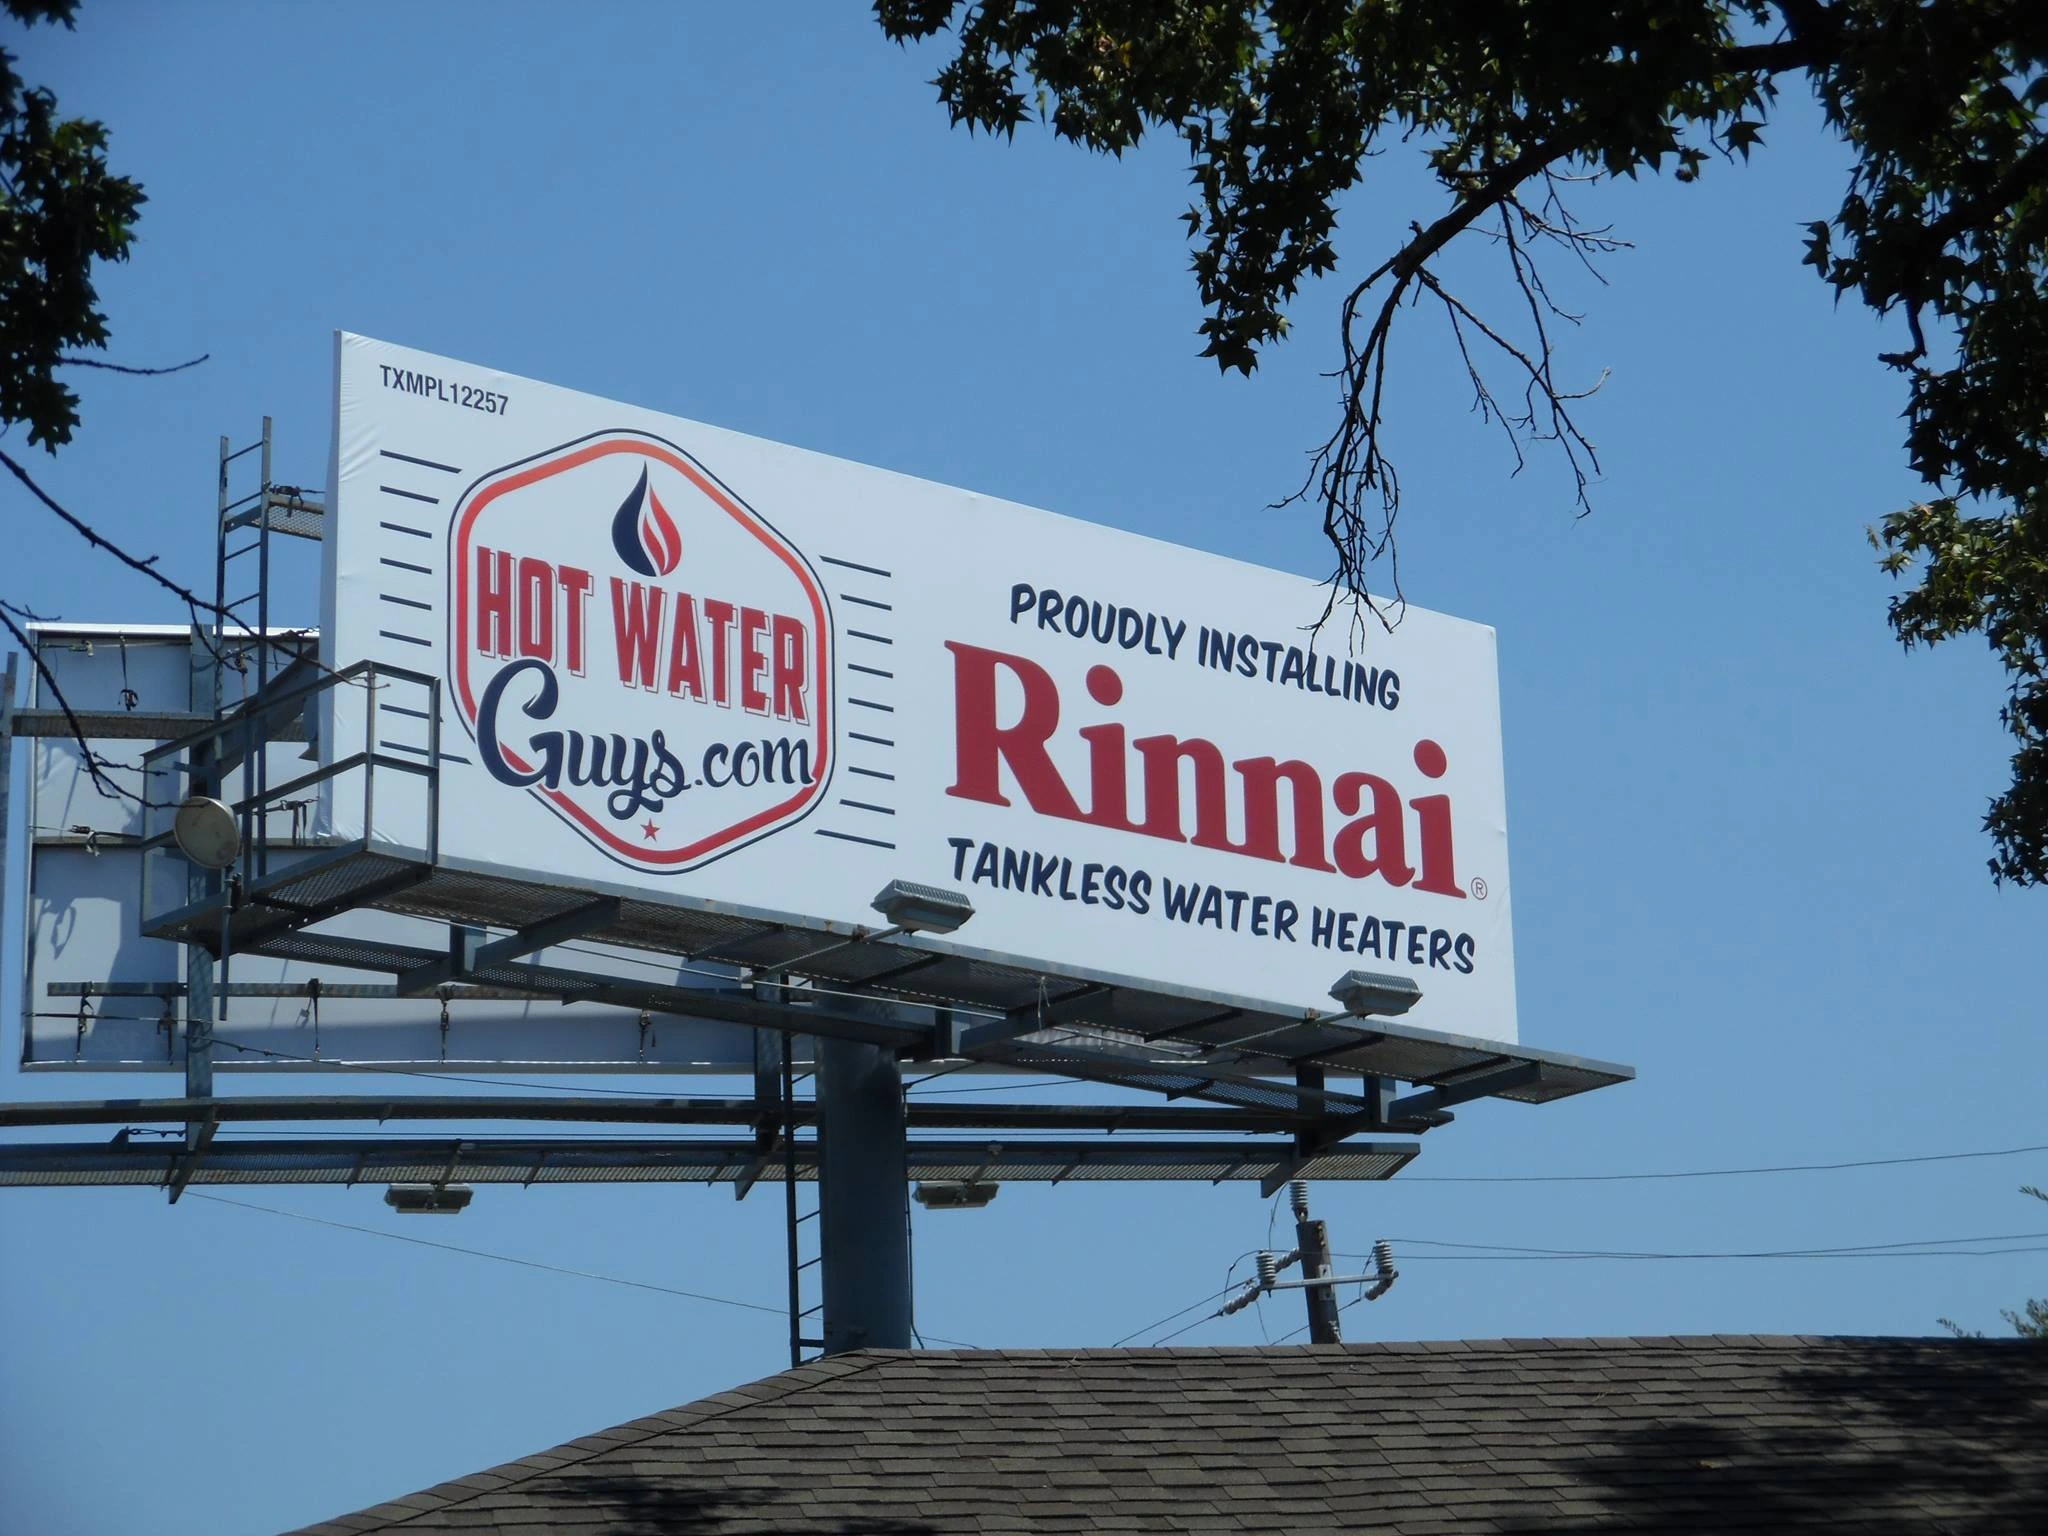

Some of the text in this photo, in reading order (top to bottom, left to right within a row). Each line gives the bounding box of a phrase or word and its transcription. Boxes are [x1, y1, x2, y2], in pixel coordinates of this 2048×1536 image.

[380, 365, 508, 416] TXMPL12257
[476, 546, 809, 725] HOT WATER
[1010, 584, 1400, 710] PROUDLY INSTALLING
[477, 660, 814, 820] Guys.com
[944, 640, 1466, 898] Rinnai
[947, 838, 1475, 974] TANKLESS WATER HEATERS
